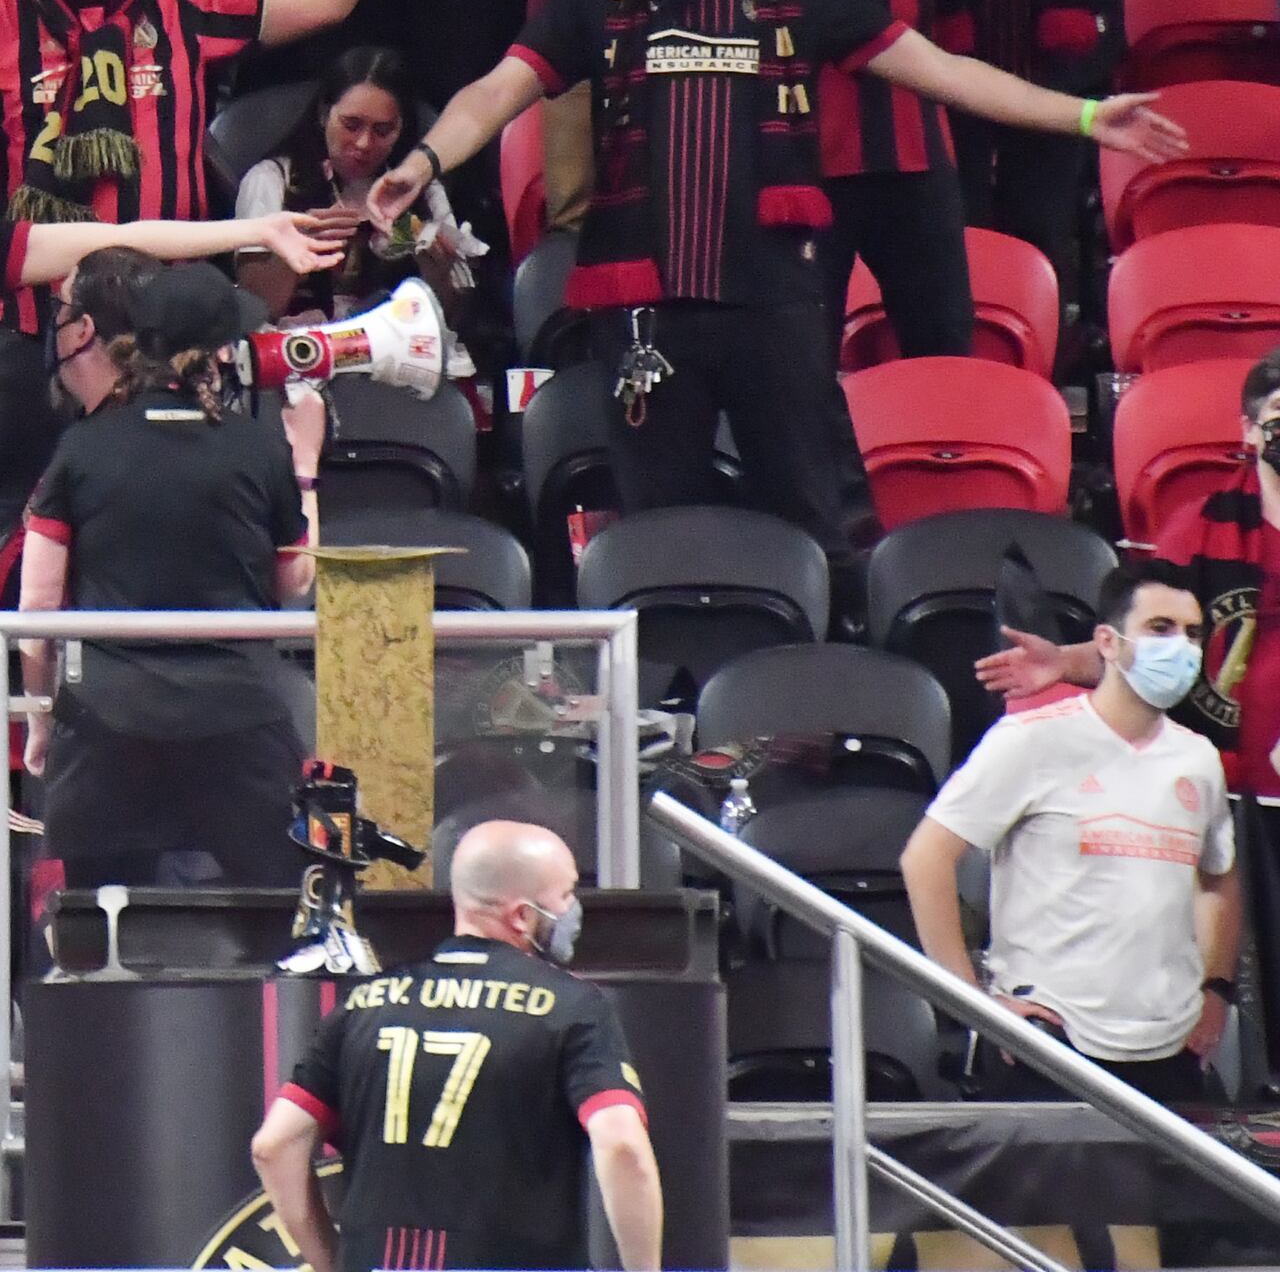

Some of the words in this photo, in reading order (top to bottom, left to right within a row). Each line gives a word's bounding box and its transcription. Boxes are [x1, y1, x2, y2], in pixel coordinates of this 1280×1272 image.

[646, 46, 712, 60] MERICAN
[650, 60, 760, 70] NSURANCE
[346, 976, 409, 1012] REV.
[419, 976, 556, 1016] UNITED
[376, 1026, 492, 1148] 17
